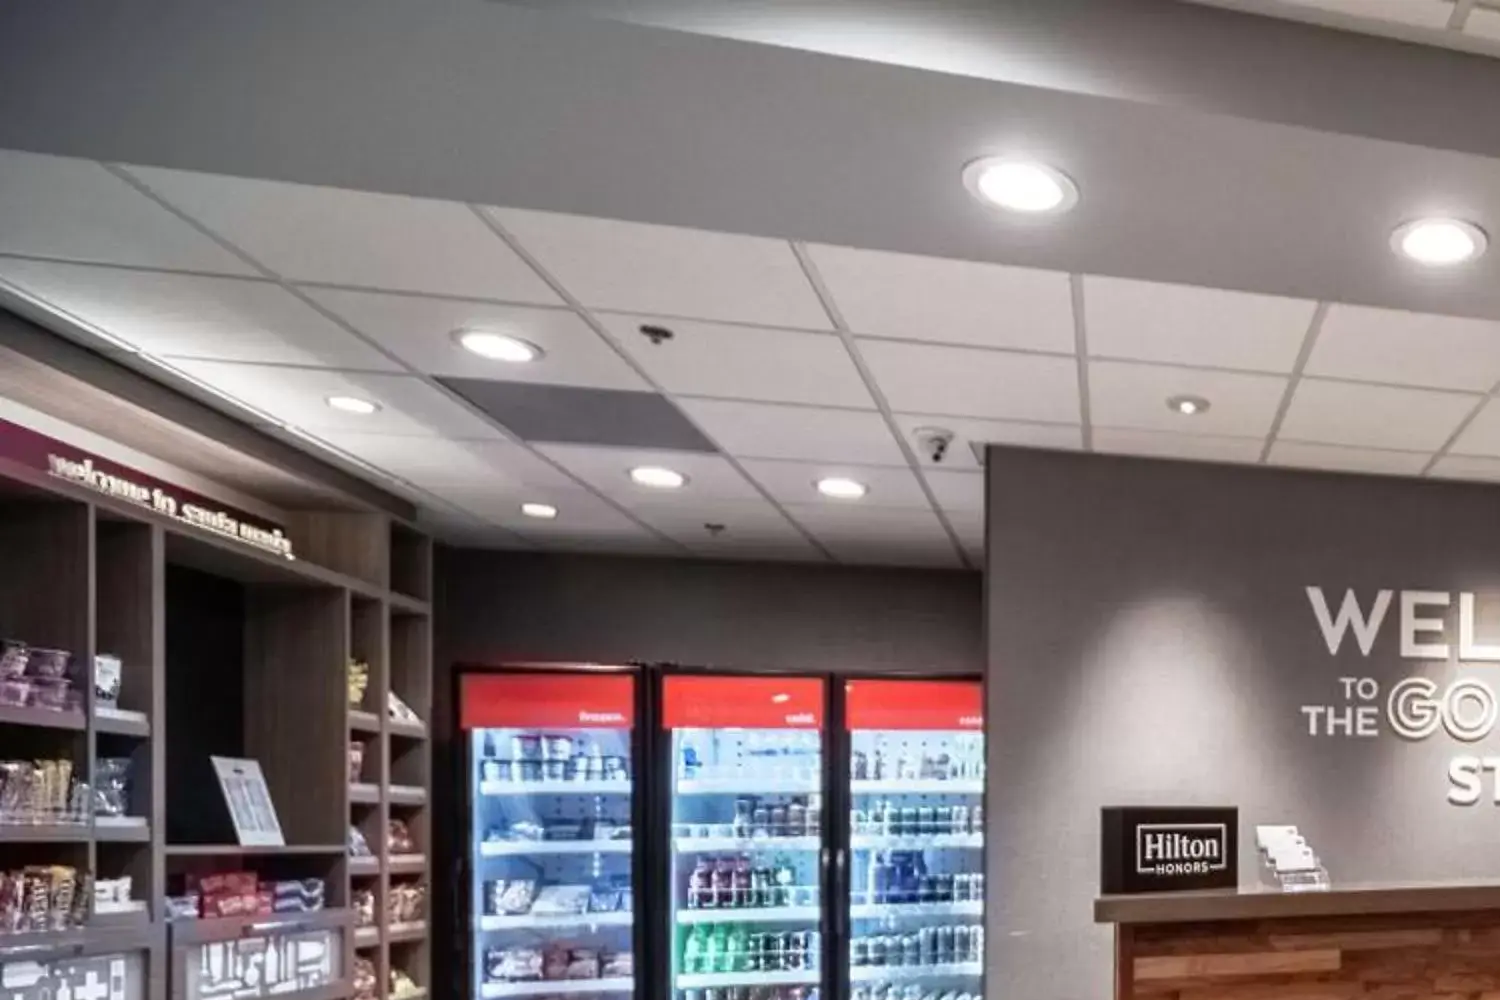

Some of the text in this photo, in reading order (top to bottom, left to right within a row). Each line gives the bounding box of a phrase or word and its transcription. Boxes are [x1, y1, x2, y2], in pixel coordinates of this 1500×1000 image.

[48, 453, 150, 502] welcome
[152, 488, 176, 518] to
[1339, 677, 1379, 700] TO
[1301, 705, 1379, 737] THE
[1144, 833, 1219, 860] Hilton
[1156, 861, 1209, 876] HONORS
